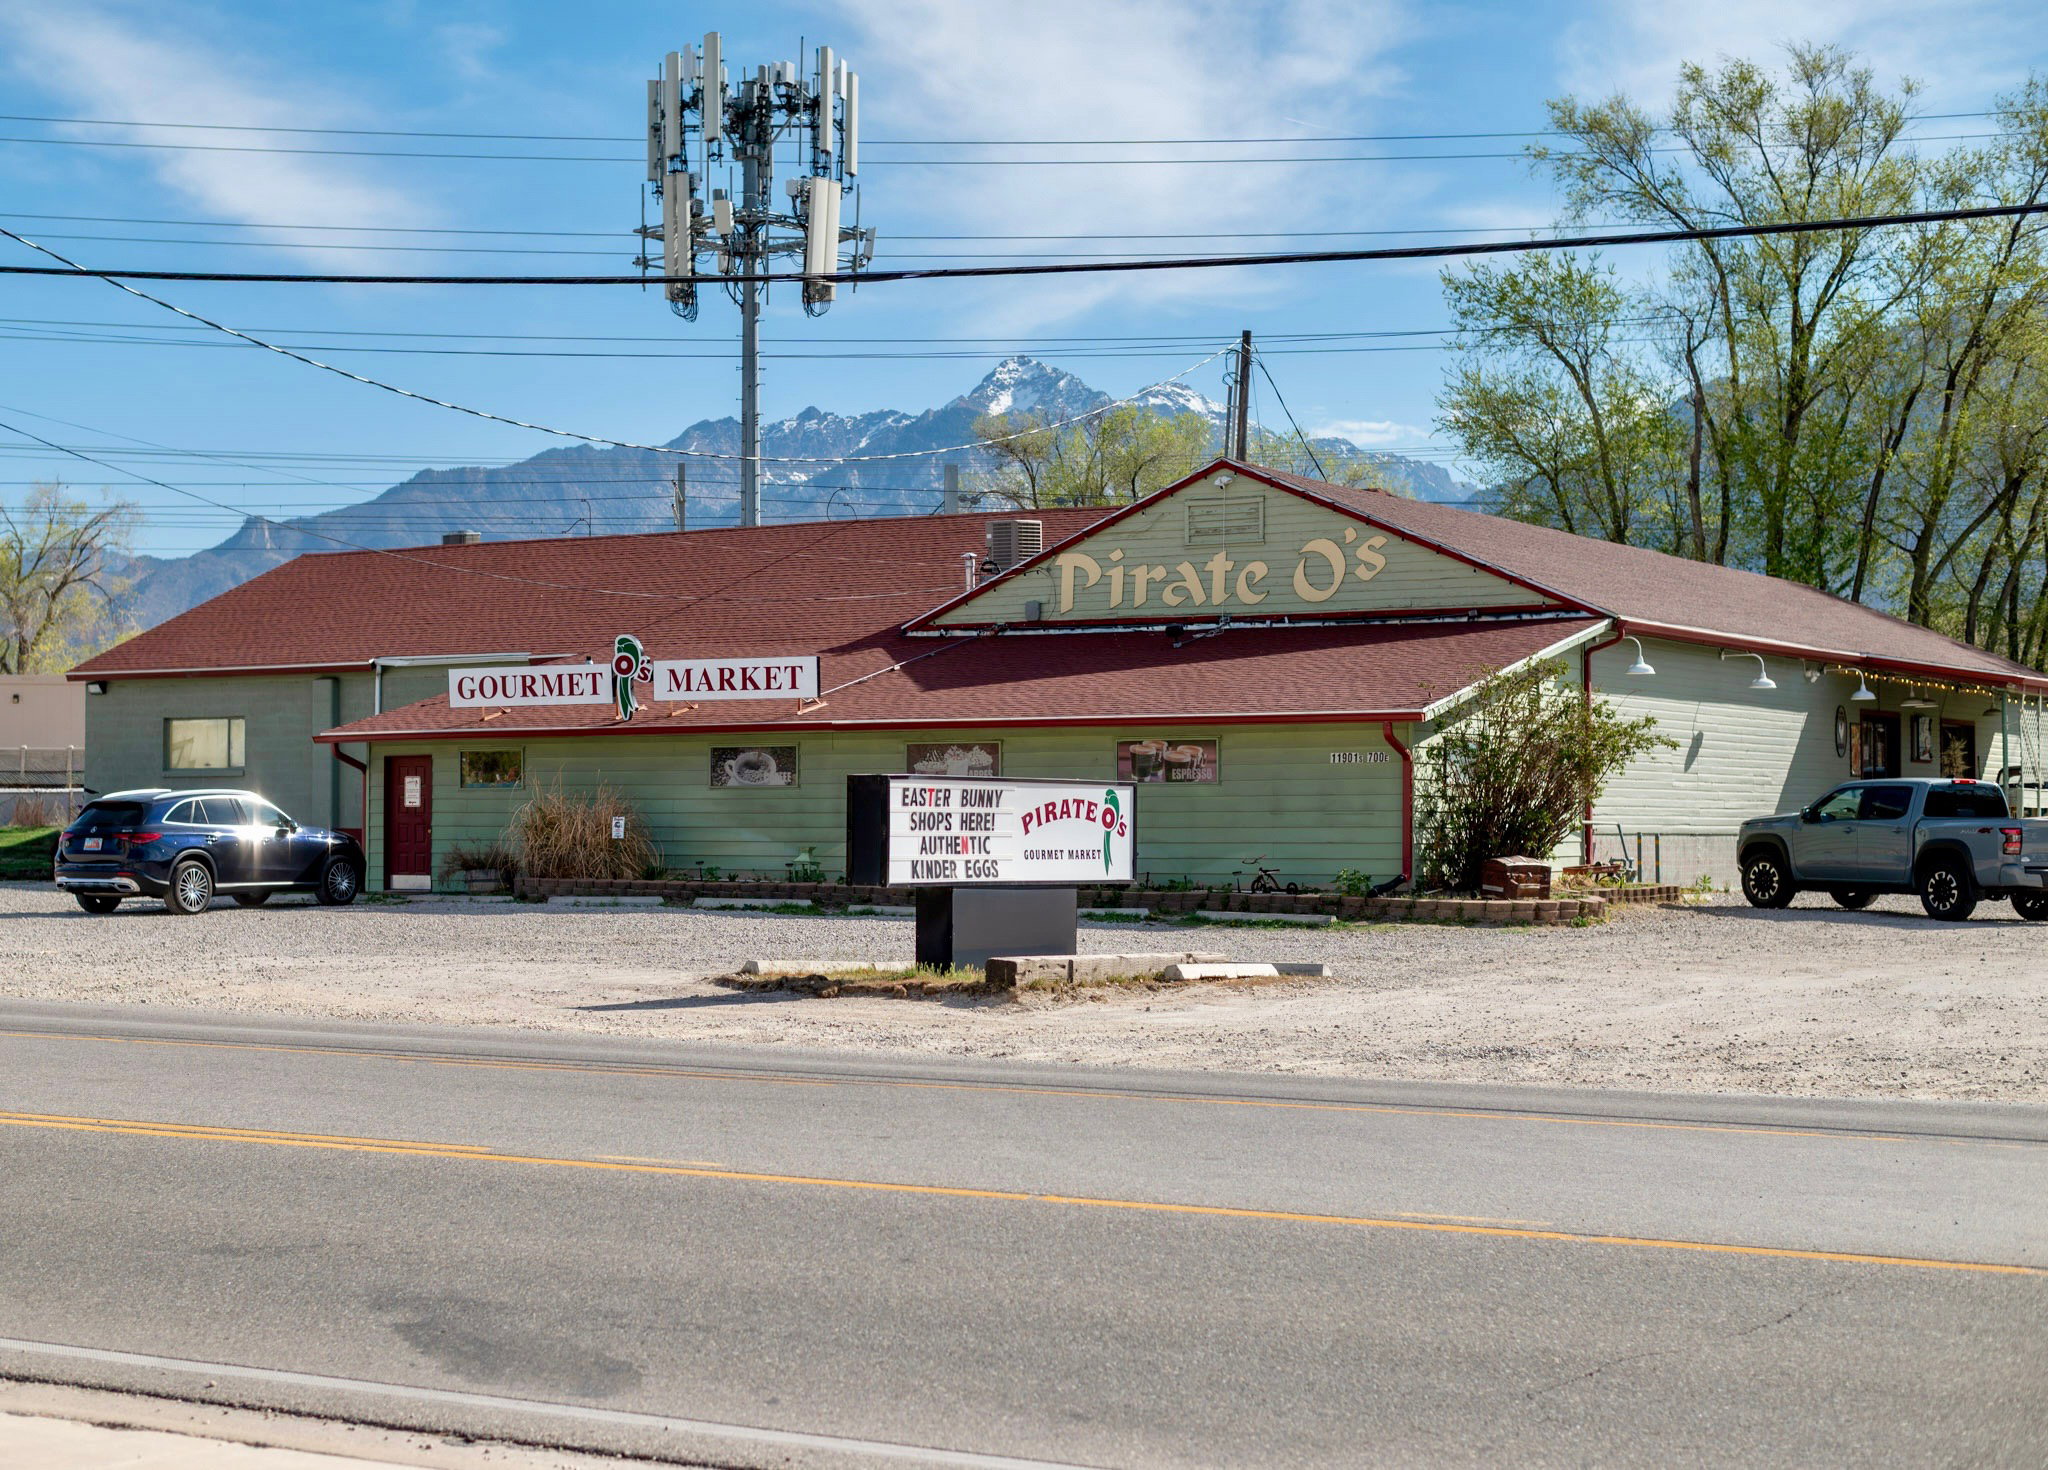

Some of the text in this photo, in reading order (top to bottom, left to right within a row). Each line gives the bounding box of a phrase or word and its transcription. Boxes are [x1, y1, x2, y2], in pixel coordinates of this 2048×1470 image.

[1054, 527, 1389, 615] Pirate O's
[457, 672, 604, 700] GOURMET
[666, 665, 804, 693] MARKET
[1171, 768, 1213, 780] ESPRESSO
[902, 787, 1003, 808] EASTER BUNNY
[910, 811, 995, 831] SHOPS HERE!
[1021, 798, 1098, 836] PIRATE
[920, 836, 991, 855] AUTHENTIC
[1023, 849, 1101, 860] GOURMET MARKET
[965, 859, 999, 878] EGGS
